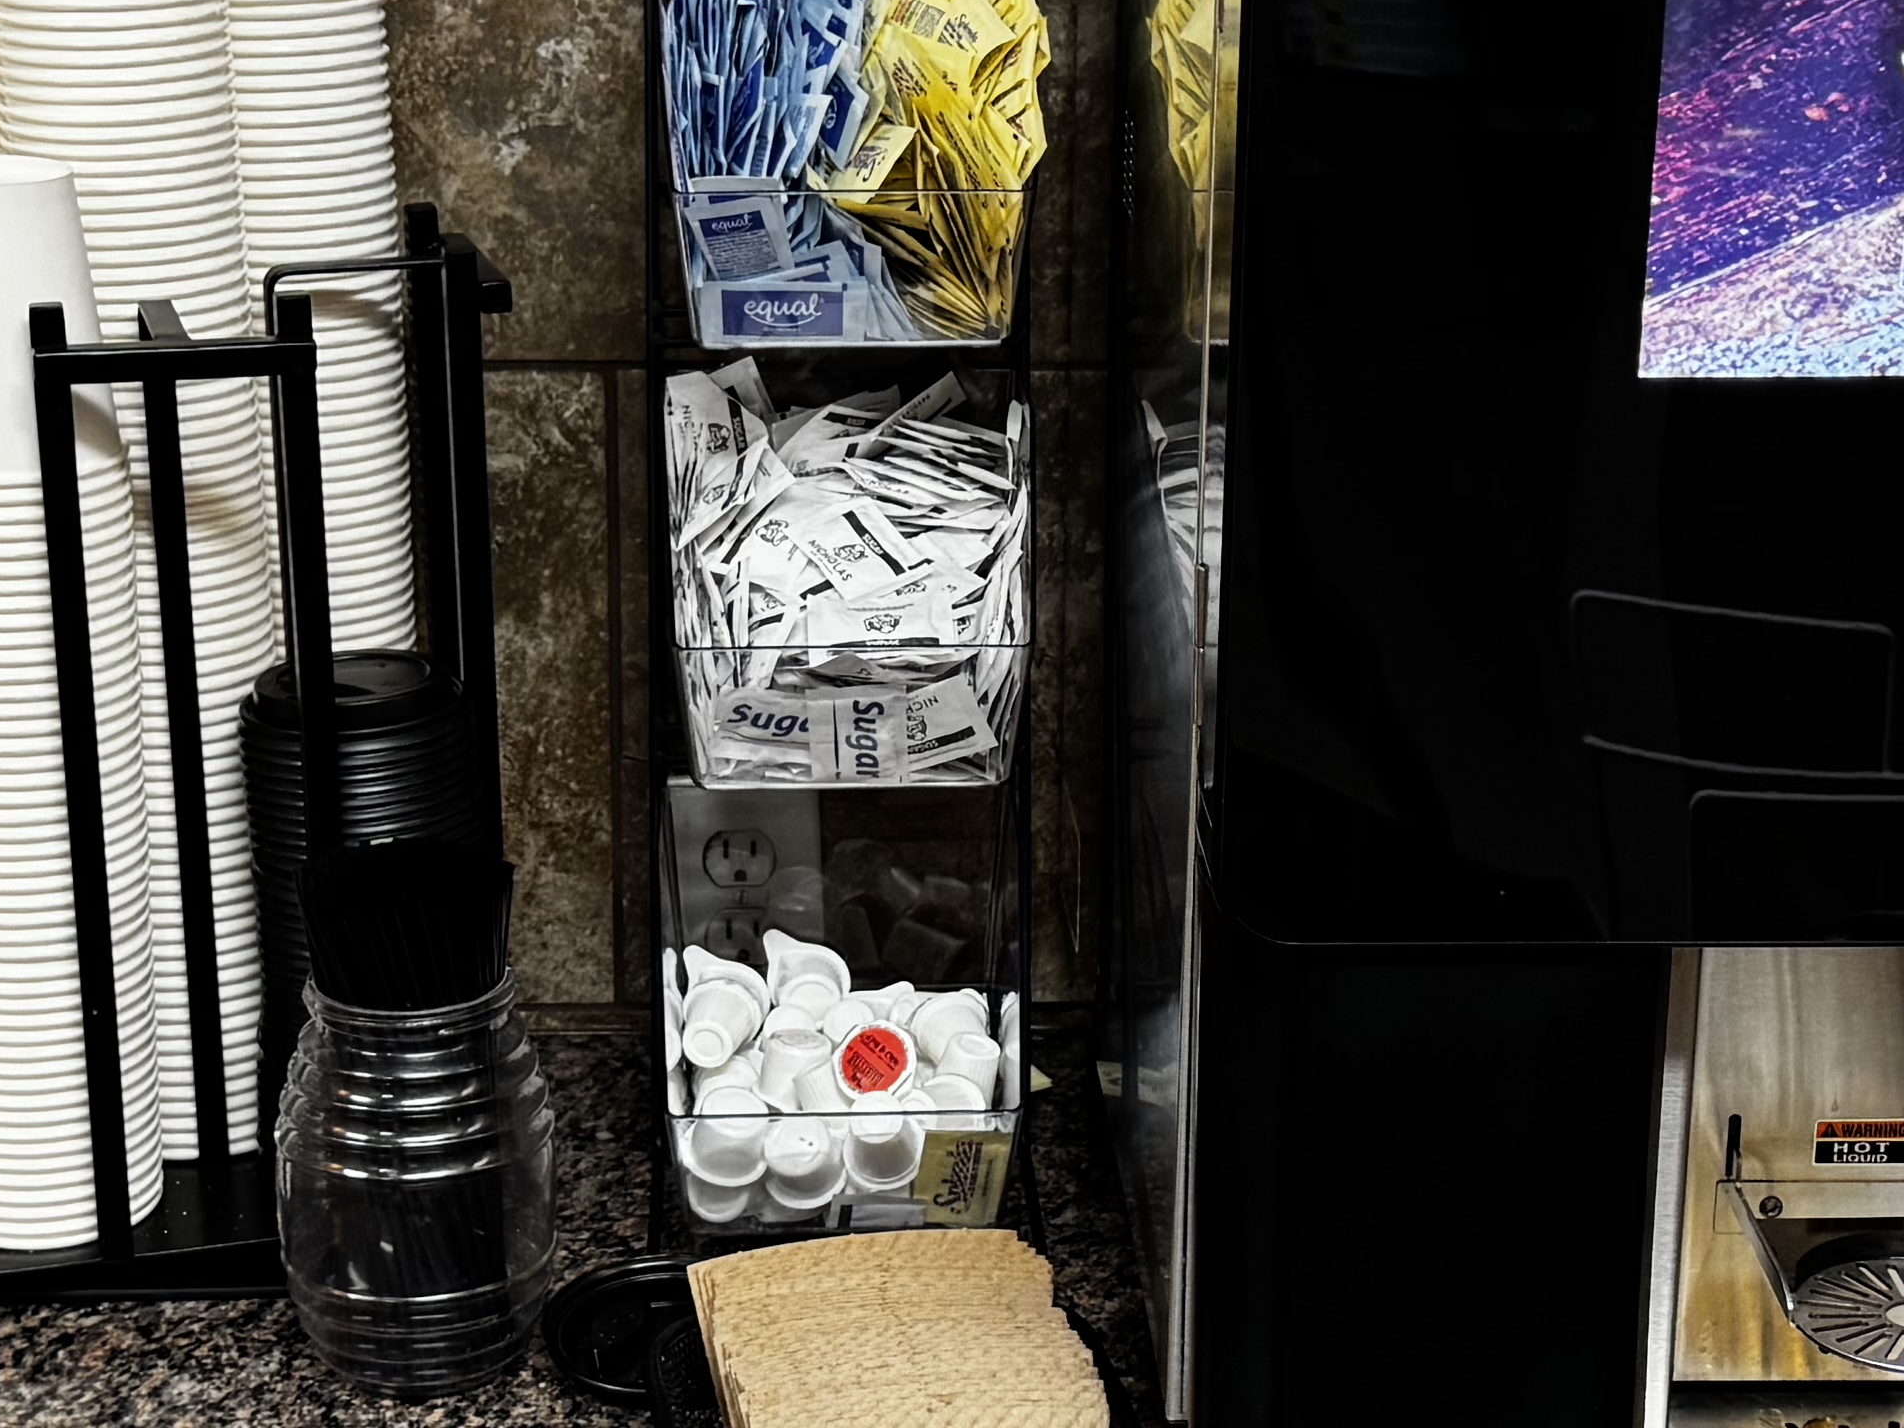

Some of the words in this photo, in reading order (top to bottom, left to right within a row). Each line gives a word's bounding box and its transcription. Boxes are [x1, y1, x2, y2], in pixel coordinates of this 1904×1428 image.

[744, 293, 822, 322] equal
[727, 703, 809, 737] Sug
[1833, 1142, 1890, 1153] HOT
[1833, 1154, 1888, 1163] LIQUID
